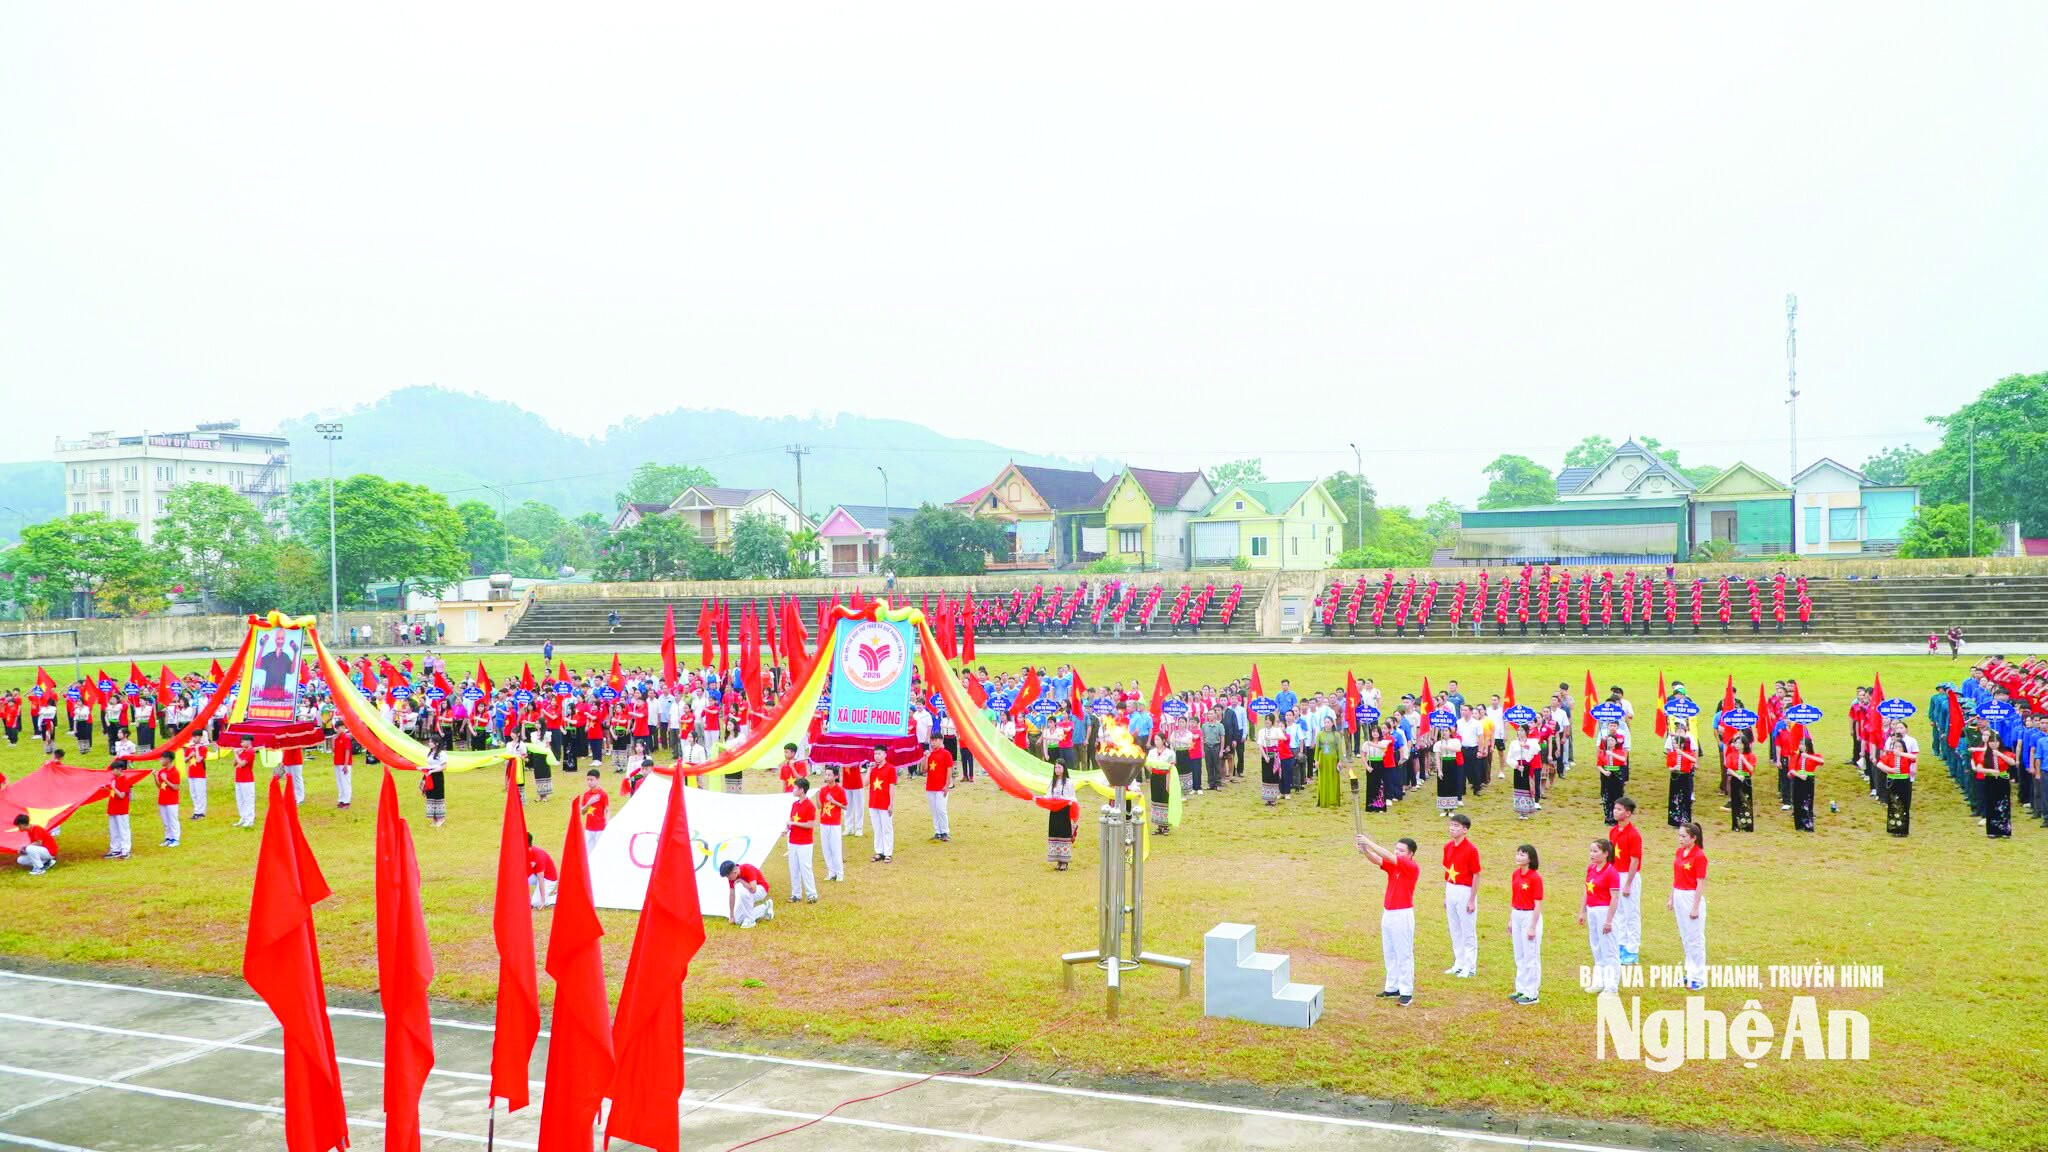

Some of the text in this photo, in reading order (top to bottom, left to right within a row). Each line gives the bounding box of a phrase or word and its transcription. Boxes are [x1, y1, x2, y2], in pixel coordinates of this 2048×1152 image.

[187, 440, 212, 449] HOTEL
[862, 671, 881, 679] 2026
[837, 703, 901, 726] XÃ QUẾ PHONG
